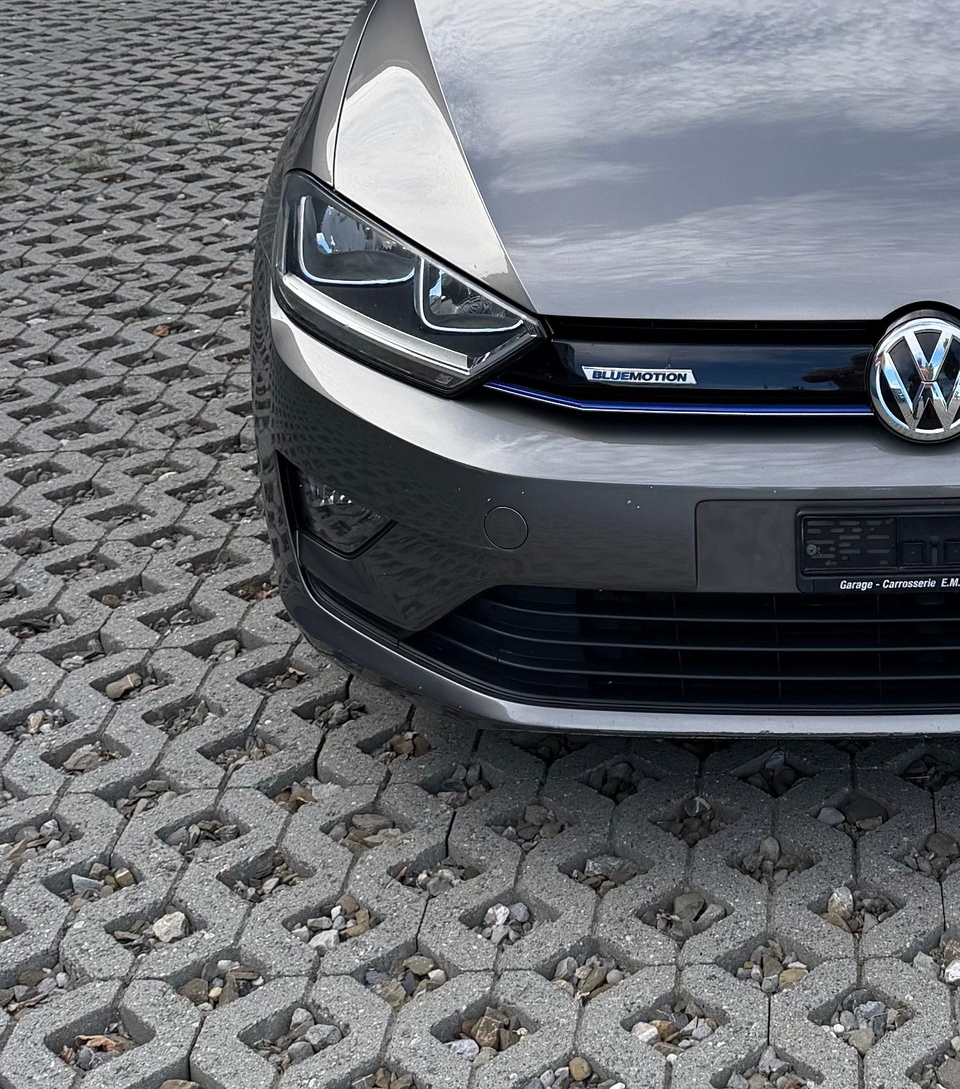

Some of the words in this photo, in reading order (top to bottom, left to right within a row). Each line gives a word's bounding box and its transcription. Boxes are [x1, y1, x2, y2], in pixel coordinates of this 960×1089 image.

[592, 370, 688, 382] BLUEMOTION
[840, 579, 874, 591] Garage
[882, 578, 937, 589] Carrosserie
[940, 577, 960, 587] E.M.
